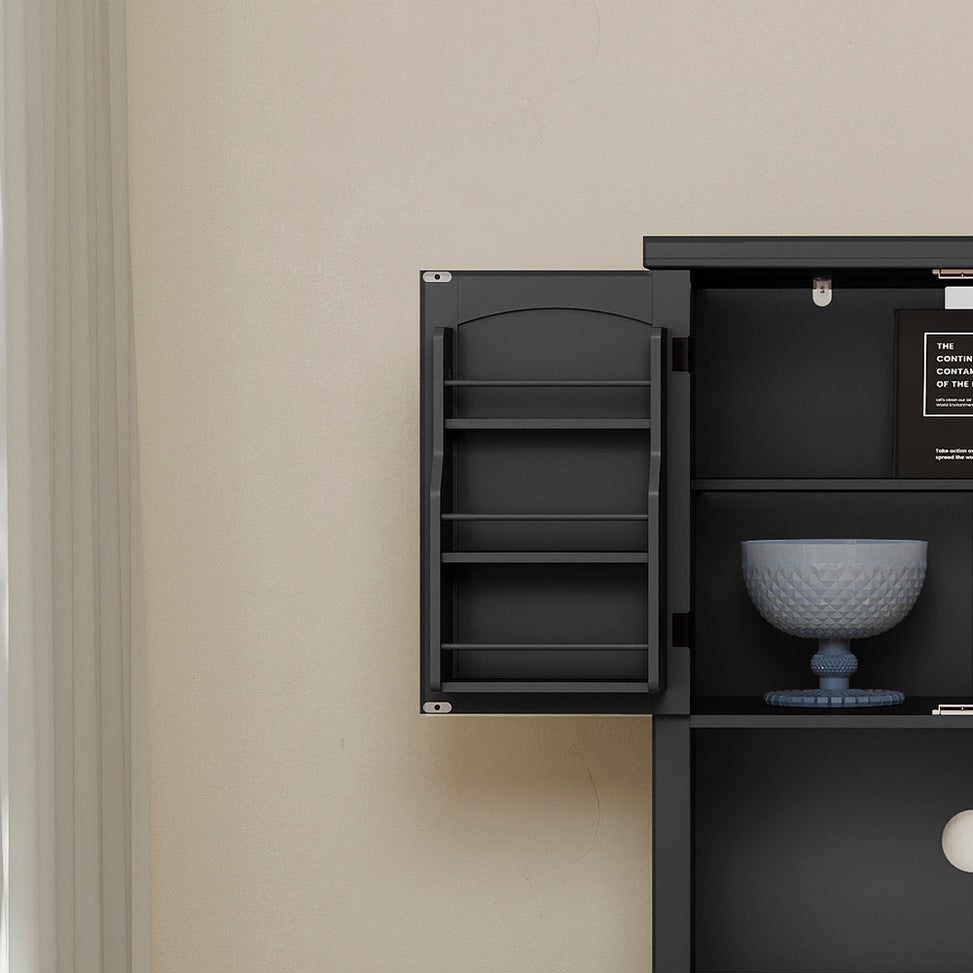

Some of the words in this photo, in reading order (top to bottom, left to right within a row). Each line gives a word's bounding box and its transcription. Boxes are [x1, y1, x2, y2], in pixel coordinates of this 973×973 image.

[936, 342, 954, 350] THE
[936, 380, 949, 388] OF
[952, 380, 969, 388] THE
